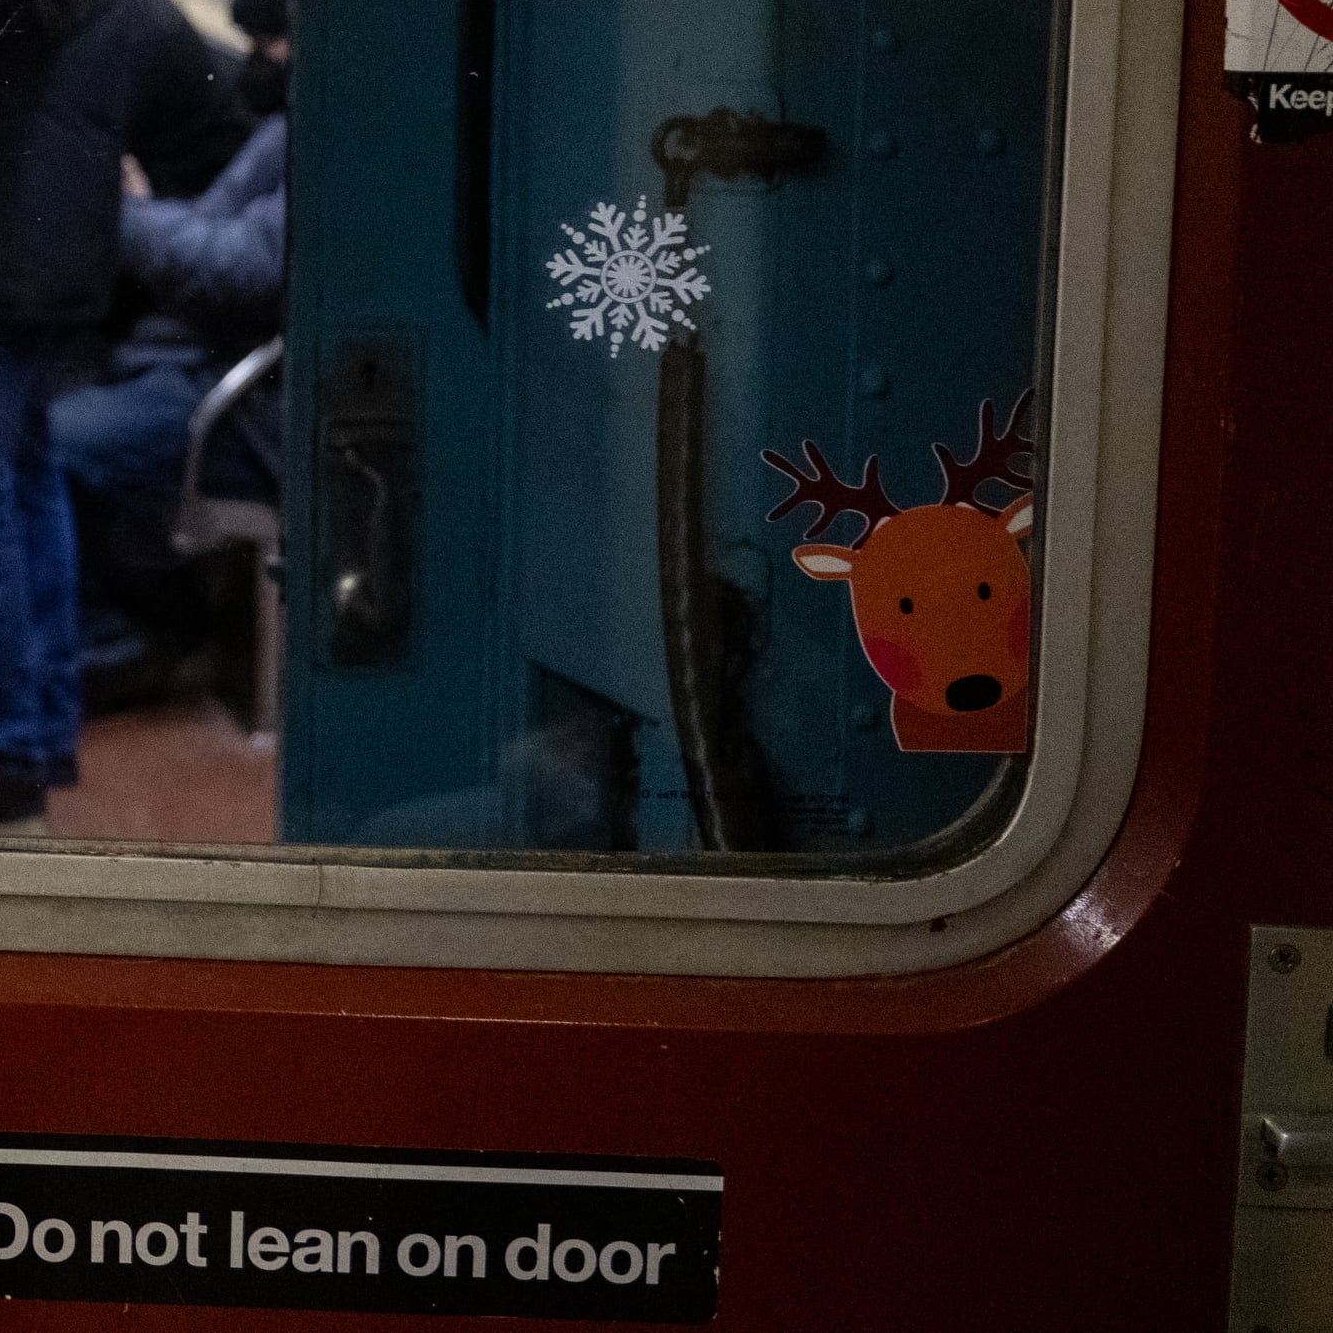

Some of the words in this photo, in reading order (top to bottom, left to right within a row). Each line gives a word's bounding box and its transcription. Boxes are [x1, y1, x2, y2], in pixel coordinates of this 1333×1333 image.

[90, 1211, 208, 1268] not
[229, 1210, 380, 1275] lean
[396, 1233, 487, 1278] on
[504, 1223, 676, 1285] door
